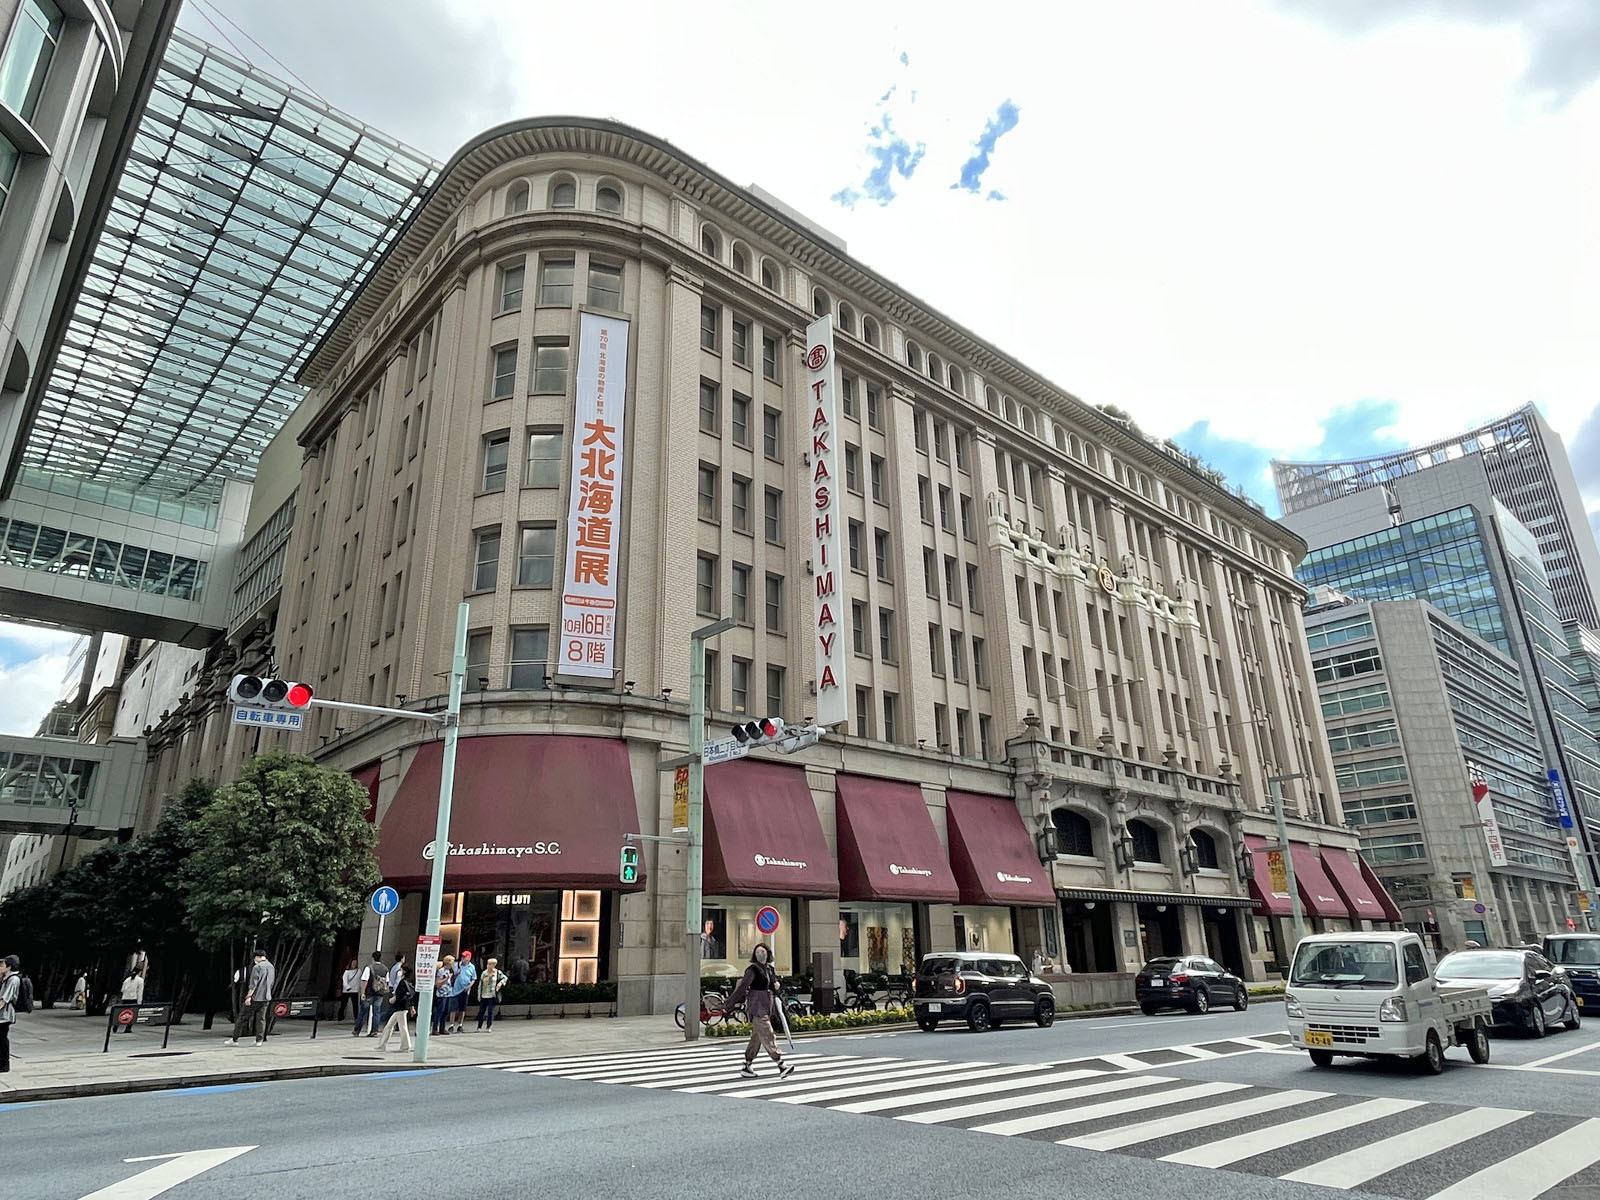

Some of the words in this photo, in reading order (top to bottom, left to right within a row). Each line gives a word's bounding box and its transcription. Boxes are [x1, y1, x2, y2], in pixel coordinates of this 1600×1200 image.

[575, 418, 616, 587] 大北海道展
[811, 379, 836, 690] TAKASHIMAYA
[236, 709, 300, 726] 自転車専用
[534, 842, 562, 855] S.C.
